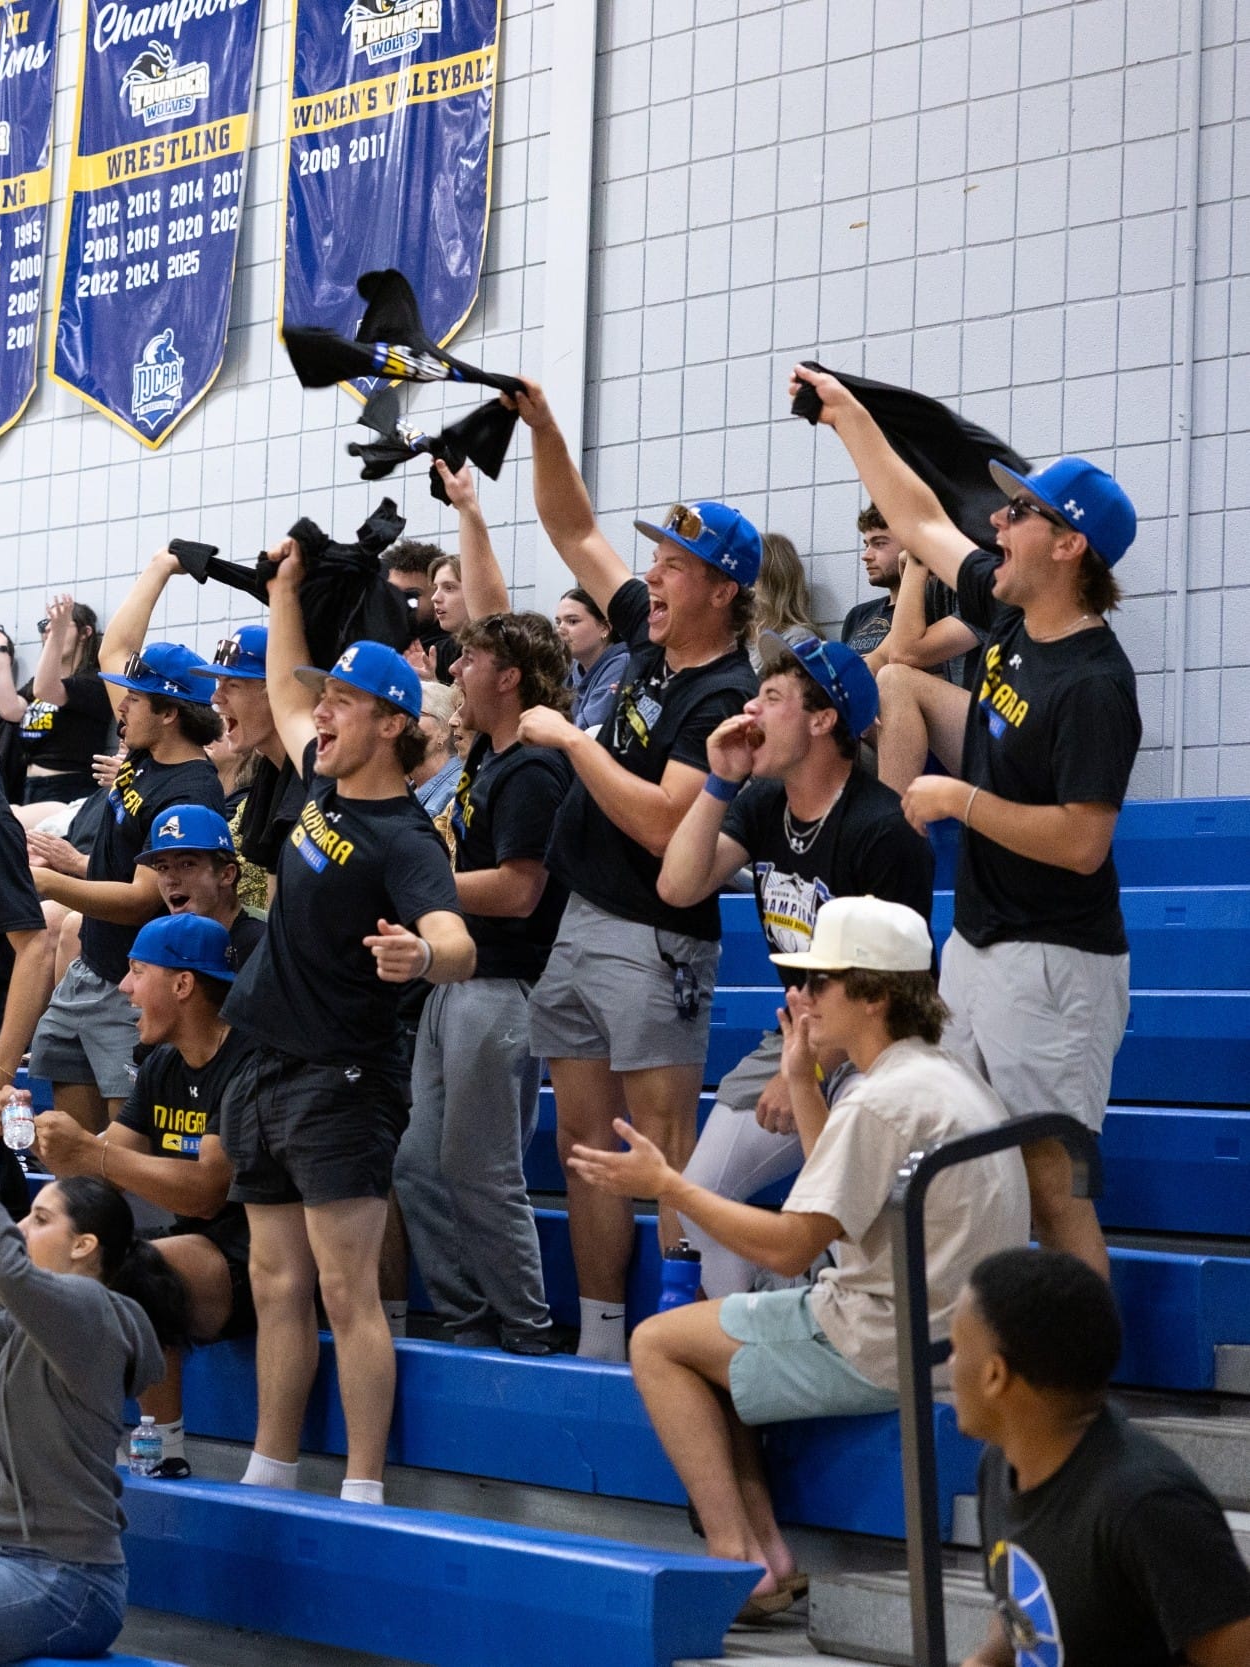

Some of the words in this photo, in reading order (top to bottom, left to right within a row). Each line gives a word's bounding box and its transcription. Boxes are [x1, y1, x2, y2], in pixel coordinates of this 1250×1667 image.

[355, 1, 440, 50] THUNDER
[370, 30, 418, 58] WOLVES
[132, 66, 207, 112] THUNDER
[146, 97, 192, 119] WOLVES
[293, 87, 378, 129] WOMEN'S
[385, 55, 493, 106] VLEYBALL
[107, 123, 230, 180] WRESTLING
[299, 144, 340, 177] 2009
[348, 132, 386, 164] 2011
[86, 200, 119, 229] 2012
[127, 189, 160, 219] 2013
[170, 178, 203, 210] 2014
[213, 168, 243, 198] 201
[14, 220, 41, 249] 1995
[83, 235, 118, 263] 2018
[127, 225, 160, 254] 2019
[168, 214, 203, 244] 2020
[9, 254, 41, 283] 2000
[78, 270, 119, 297] 2022
[125, 260, 159, 290] 2024
[167, 250, 200, 280] 2025
[7, 288, 40, 317] 2005
[7, 323, 34, 351] 2011
